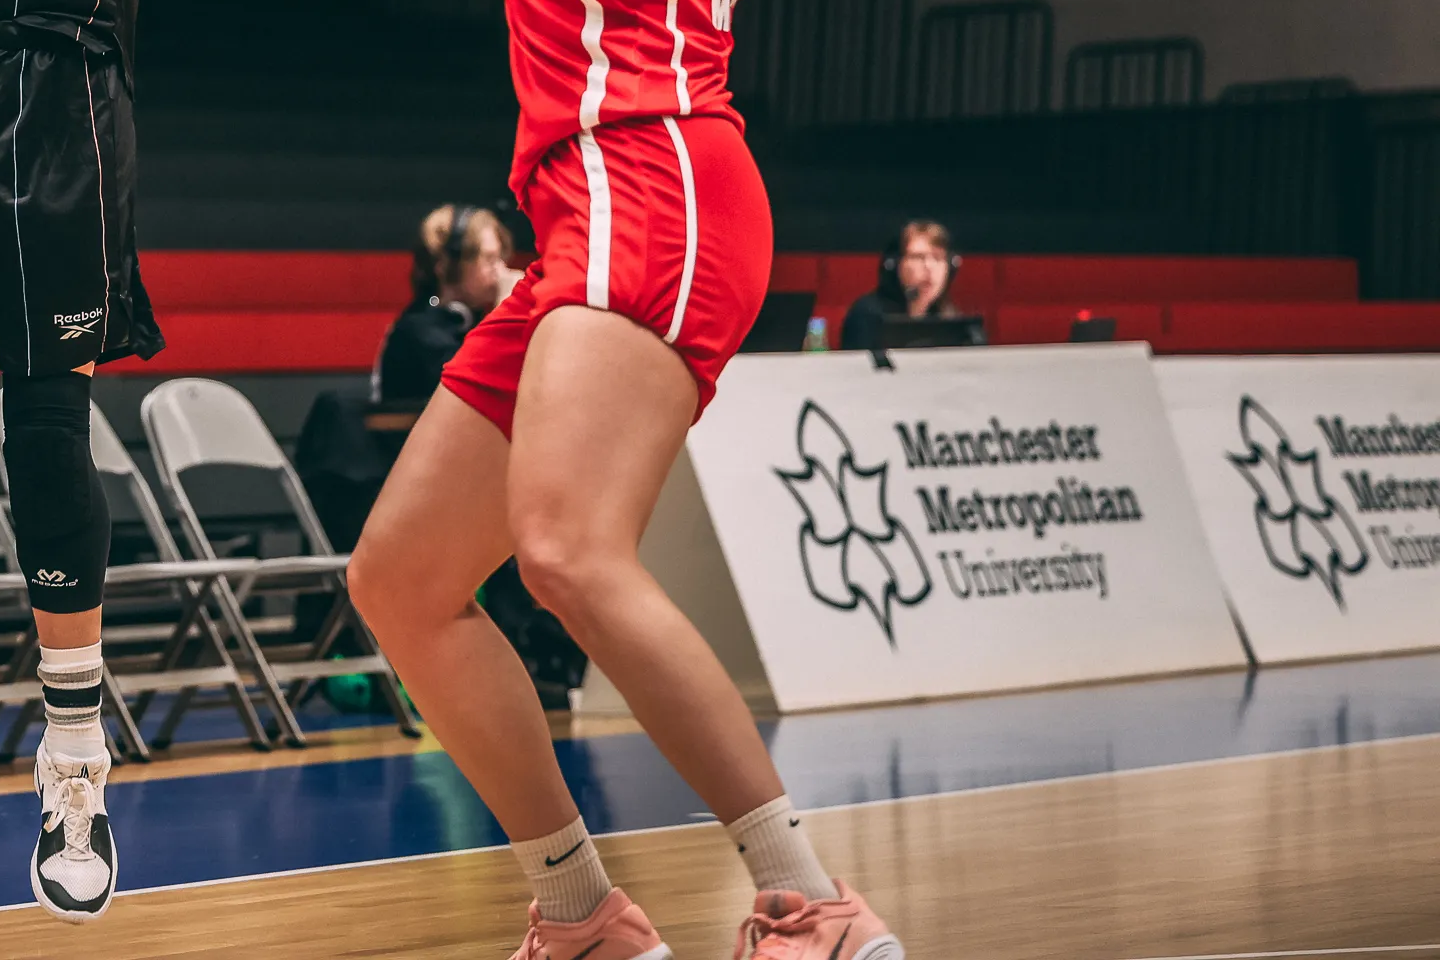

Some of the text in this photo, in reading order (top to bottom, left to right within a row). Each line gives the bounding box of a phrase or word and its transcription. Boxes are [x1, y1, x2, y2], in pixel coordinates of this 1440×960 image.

[53, 307, 103, 326] Reebok
[894, 416, 1103, 470] Manchester
[915, 476, 1146, 539] Metropolitan
[936, 540, 1110, 599] University
